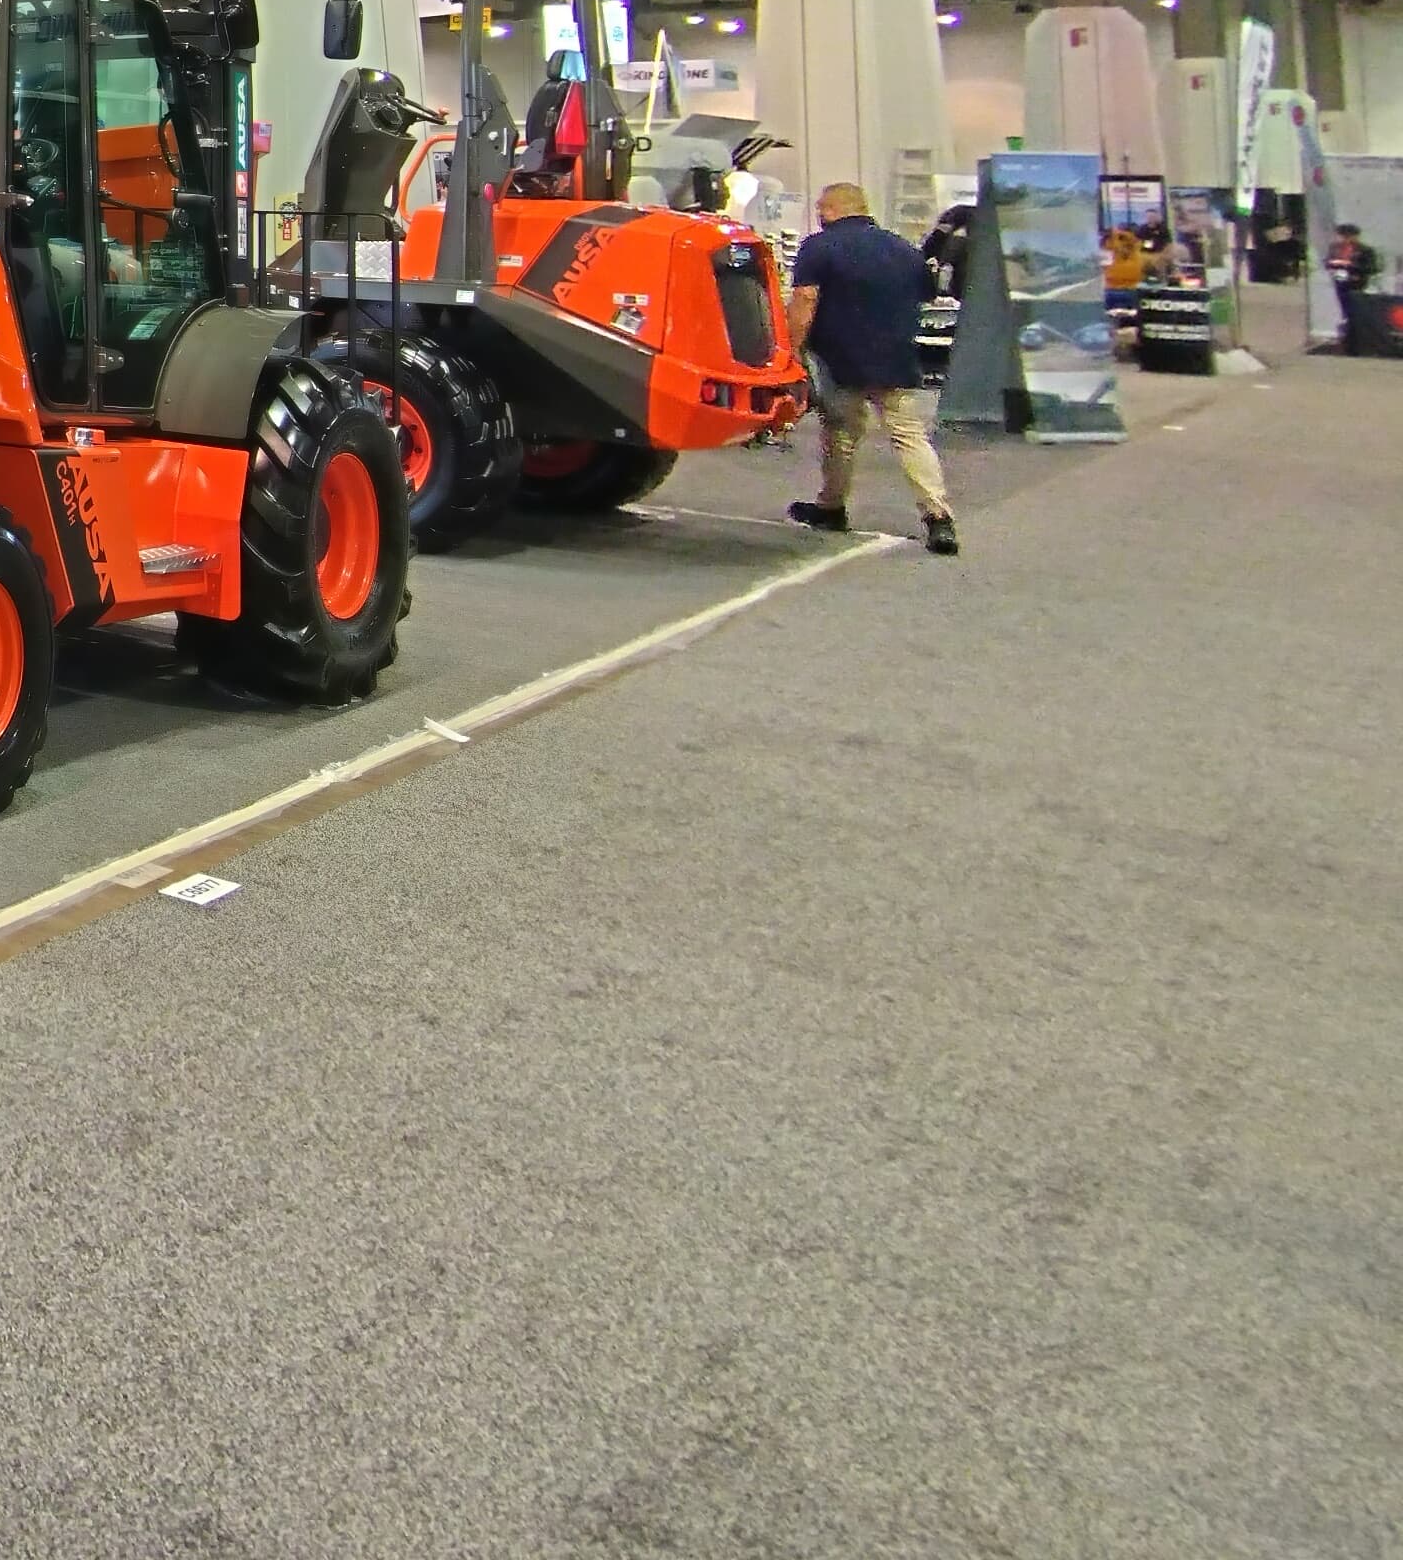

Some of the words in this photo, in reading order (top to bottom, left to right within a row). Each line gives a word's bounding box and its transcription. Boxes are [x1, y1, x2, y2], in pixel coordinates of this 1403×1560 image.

[238, 77, 248, 169] AUSA
[552, 225, 618, 304] AUSA
[66, 456, 115, 604] AUSA
